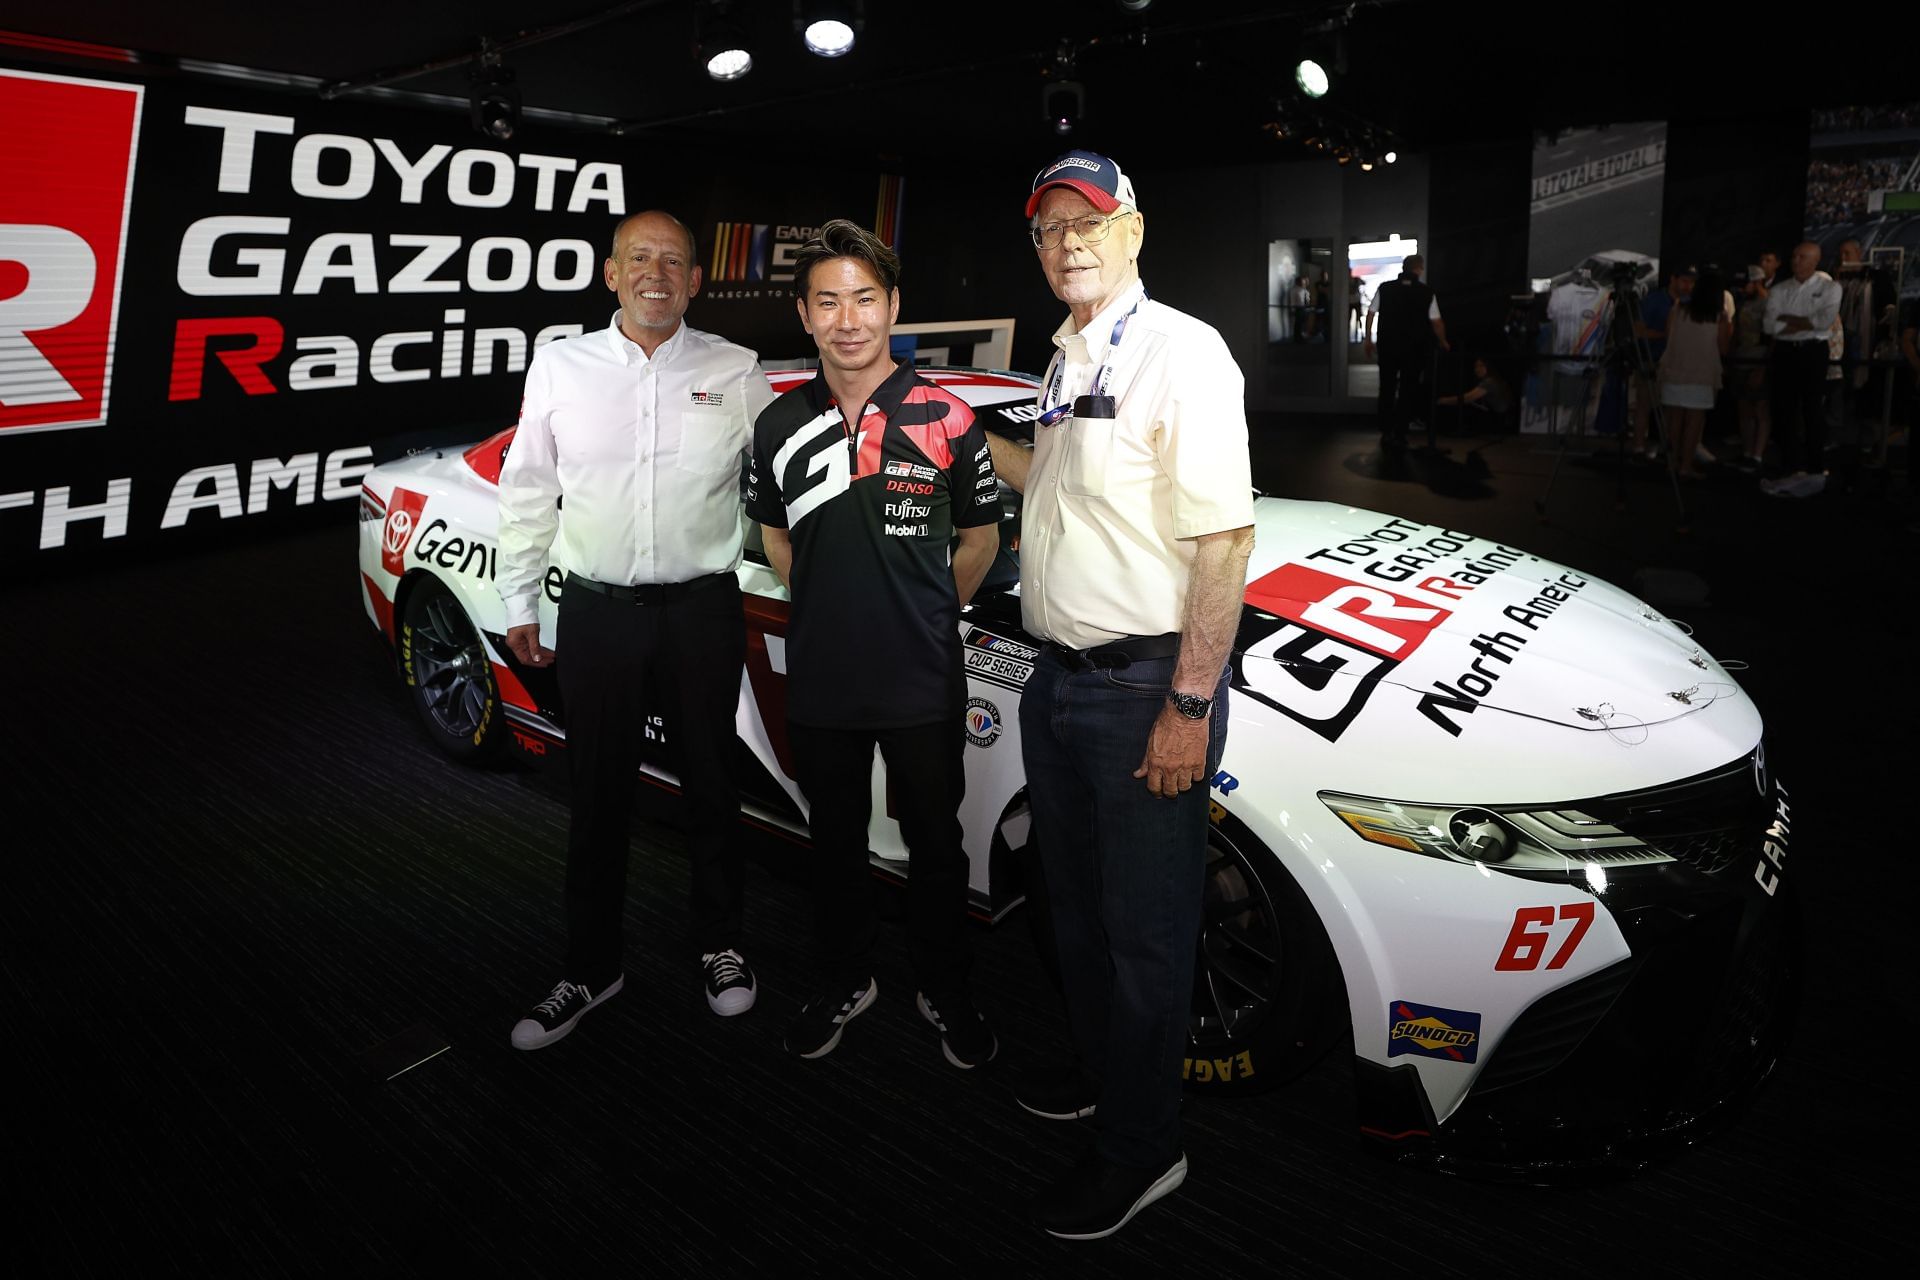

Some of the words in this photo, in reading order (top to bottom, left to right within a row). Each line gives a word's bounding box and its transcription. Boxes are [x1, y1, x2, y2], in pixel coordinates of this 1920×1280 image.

[185, 106, 626, 214] TOYOTA
[1056, 158, 1099, 171] NASCAR
[776, 225, 823, 241] GARA
[177, 216, 595, 296] GAZOO
[707, 290, 761, 299] NASCAR
[768, 290, 783, 299] TO
[0, 223, 97, 407] R
[161, 446, 374, 529] AME
[886, 480, 935, 496] DENSO
[885, 498, 931, 520] FUJITSU
[885, 524, 917, 537] Mobil
[1305, 519, 1424, 565] TOYOT
[402, 622, 416, 687] EAGLE
[988, 640, 1038, 660] NASCAR
[968, 652, 992, 669] CUP
[991, 659, 1029, 680] SERIES
[1416, 631, 1528, 738] North
[1494, 902, 1595, 972] 67
[1395, 1021, 1475, 1047] SUNOCO
